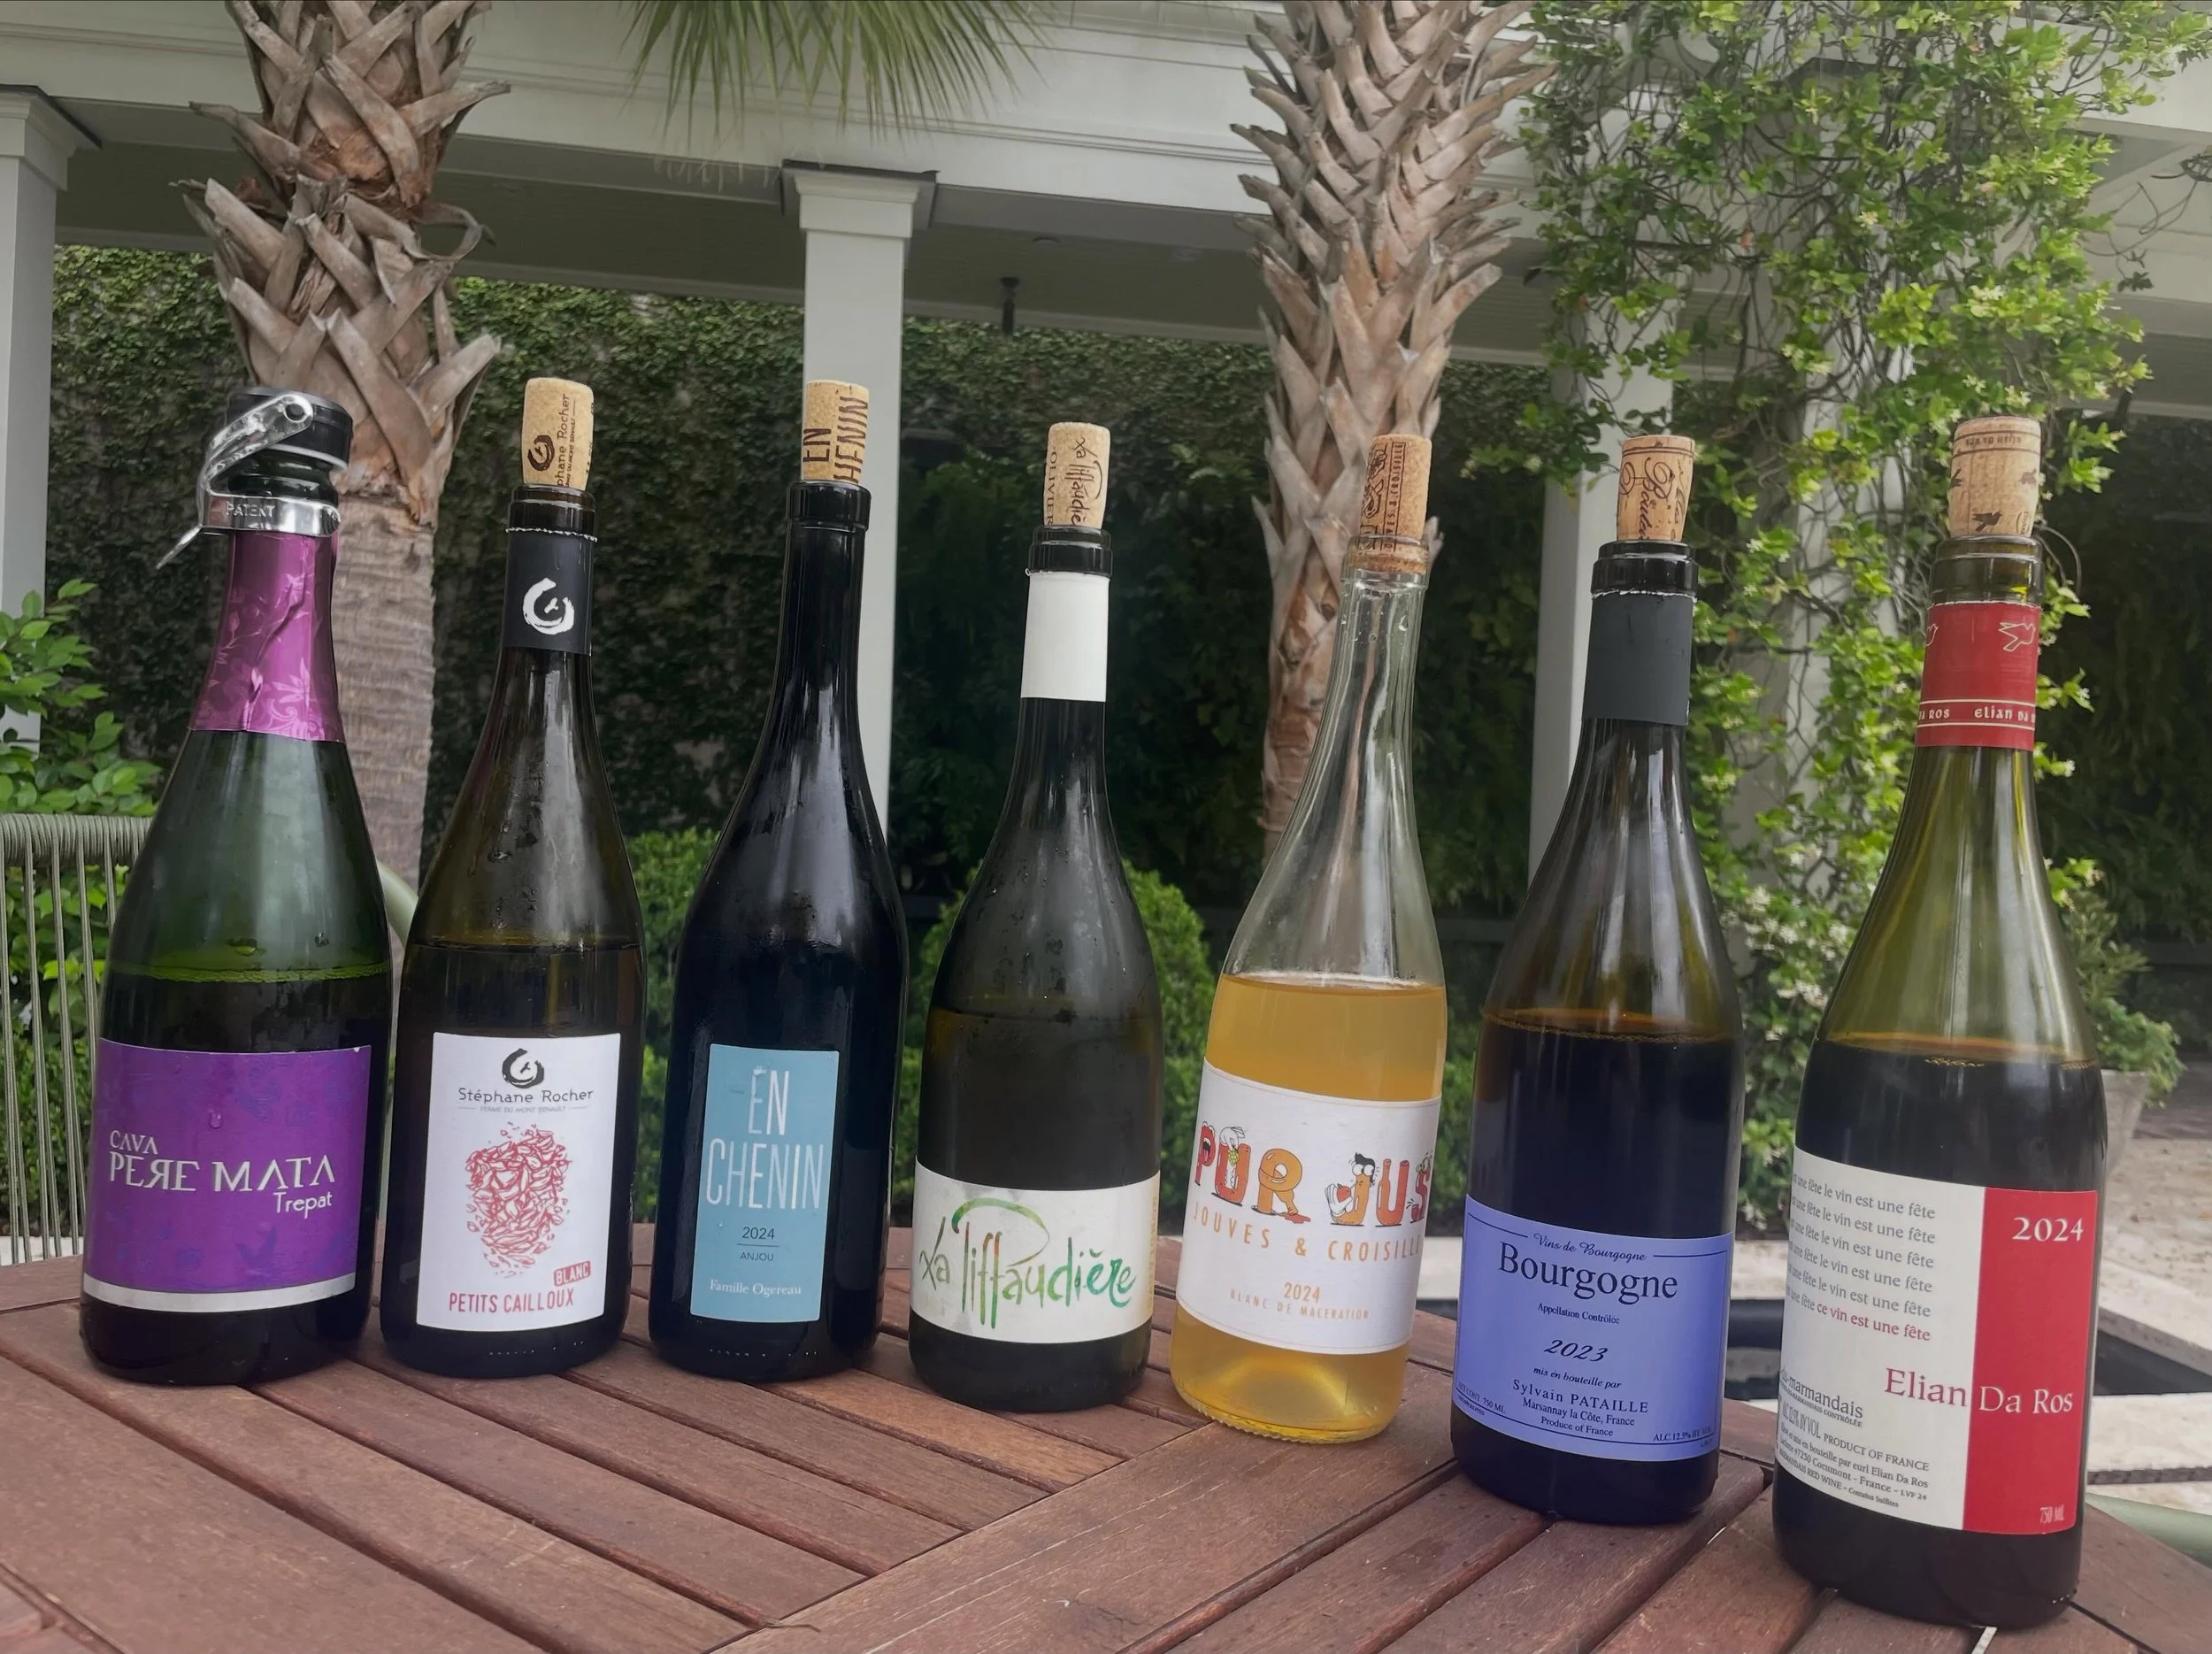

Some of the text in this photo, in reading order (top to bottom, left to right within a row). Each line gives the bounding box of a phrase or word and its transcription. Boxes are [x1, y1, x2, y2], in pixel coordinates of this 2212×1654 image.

[557, 393, 570, 440] Rocher
[803, 428, 832, 462] EN
[1047, 451, 1057, 526] OLIVIER
[226, 501, 275, 518] PATENT
[458, 1088, 594, 1103] Stéphane Rocher
[748, 1069, 789, 1135] EN
[110, 1130, 158, 1155] CAVA
[211, 1154, 335, 1192] MATA
[706, 1138, 824, 1210] CHENIN
[1194, 1121, 1433, 1227] PUR JUS
[273, 1191, 333, 1219] Trepat
[1808, 1179, 1823, 1195] fête
[1824, 1183, 1833, 1197] le
[1835, 1189, 1852, 1204] vin
[1855, 1196, 1874, 1208] est
[1878, 1201, 1904, 1214] une
[1909, 1203, 1936, 1219] fête
[742, 1227, 775, 1240] 2024
[1194, 1202, 1271, 1249] JOUVES
[1294, 1237, 1307, 1257] &
[1806, 1202, 1821, 1219] fête
[1823, 1207, 1832, 1222] le
[1834, 1212, 1851, 1227] vin
[1855, 1219, 1874, 1233] est
[1877, 1225, 1904, 1239] une
[1909, 1227, 1936, 1243] fête
[2011, 1216, 2084, 1242] 2024
[740, 1252, 774, 1262] ANJOU
[1533, 1233, 1647, 1264] Vins de Bourgogne
[1805, 1224, 1819, 1241] fête
[1821, 1230, 1830, 1245] le
[1832, 1236, 1849, 1251] vin
[1853, 1243, 1872, 1257] est
[1875, 1249, 1902, 1263] une
[1907, 1251, 1935, 1268] fête
[556, 1263, 590, 1284] BLANC
[1499, 1242, 1678, 1305] Bourgogne
[1804, 1247, 1818, 1265] fête
[1820, 1254, 1829, 1268] le
[1831, 1259, 1848, 1275] vin
[1851, 1267, 1870, 1281] est
[1874, 1273, 1901, 1288] une
[1905, 1276, 1933, 1293] fête
[449, 1288, 574, 1313] PETITS CAILLOUX
[710, 1279, 802, 1298] Famille Ogereau
[1230, 1289, 1268, 1309] BLANC
[1277, 1302, 1292, 1315] DE
[1284, 1282, 1320, 1303] 2024
[1802, 1270, 1816, 1288] fête
[1818, 1277, 1827, 1292] le
[1829, 1283, 1847, 1299] vin
[1850, 1291, 1869, 1304] est
[1872, 1297, 1900, 1312] une
[1903, 1300, 1932, 1318] fête
[1537, 1303, 1620, 1325] Appellation Contrôlée
[1801, 1293, 1816, 1311] fête
[1816, 1303, 1828, 1315] ce
[1830, 1307, 1847, 1322] vin
[1851, 1315, 1870, 1328] est
[1873, 1320, 1900, 1335] une
[1903, 1324, 1932, 1342] fête
[1544, 1339, 1609, 1363] 2023
[1532, 1366, 1622, 1390] mis en bouteille par
[1884, 1367, 2073, 1414] Elian Da Ros
[1482, 1397, 1494, 1408] 750
[1513, 1379, 1649, 1413] Sylvain PATAILLE
[1523, 1397, 1635, 1427] Marsannay la Côte, France
[1540, 1416, 1614, 1436] Produce of France
[1824, 1409, 1863, 1427] CONTRÔLÉE
[1809, 1442, 1837, 1463] bouteille
[1839, 1457, 1851, 1468] par
[1853, 1461, 1869, 1474] eurl
[1871, 1466, 1893, 1481] Elian
[1896, 1473, 1909, 1484] Da
[1911, 1477, 1929, 1489] Ros
[1824, 1433, 1866, 1456] PRODUCT
[1869, 1449, 1883, 1460] OF
[1886, 1453, 1930, 1471] FRANCE
[1794, 1446, 1812, 1464] 47250
[1812, 1458, 1852, 1481] Cocumont
[1859, 1476, 1892, 1493] France
[1917, 1493, 1927, 1502] 24
[1807, 1469, 1819, 1481] RED
[1821, 1473, 1842, 1490] WINE
[1848, 1487, 1874, 1501] Contains
[1876, 1496, 1899, 1508] Sulfites
[2039, 1506, 2053, 1524] 750
